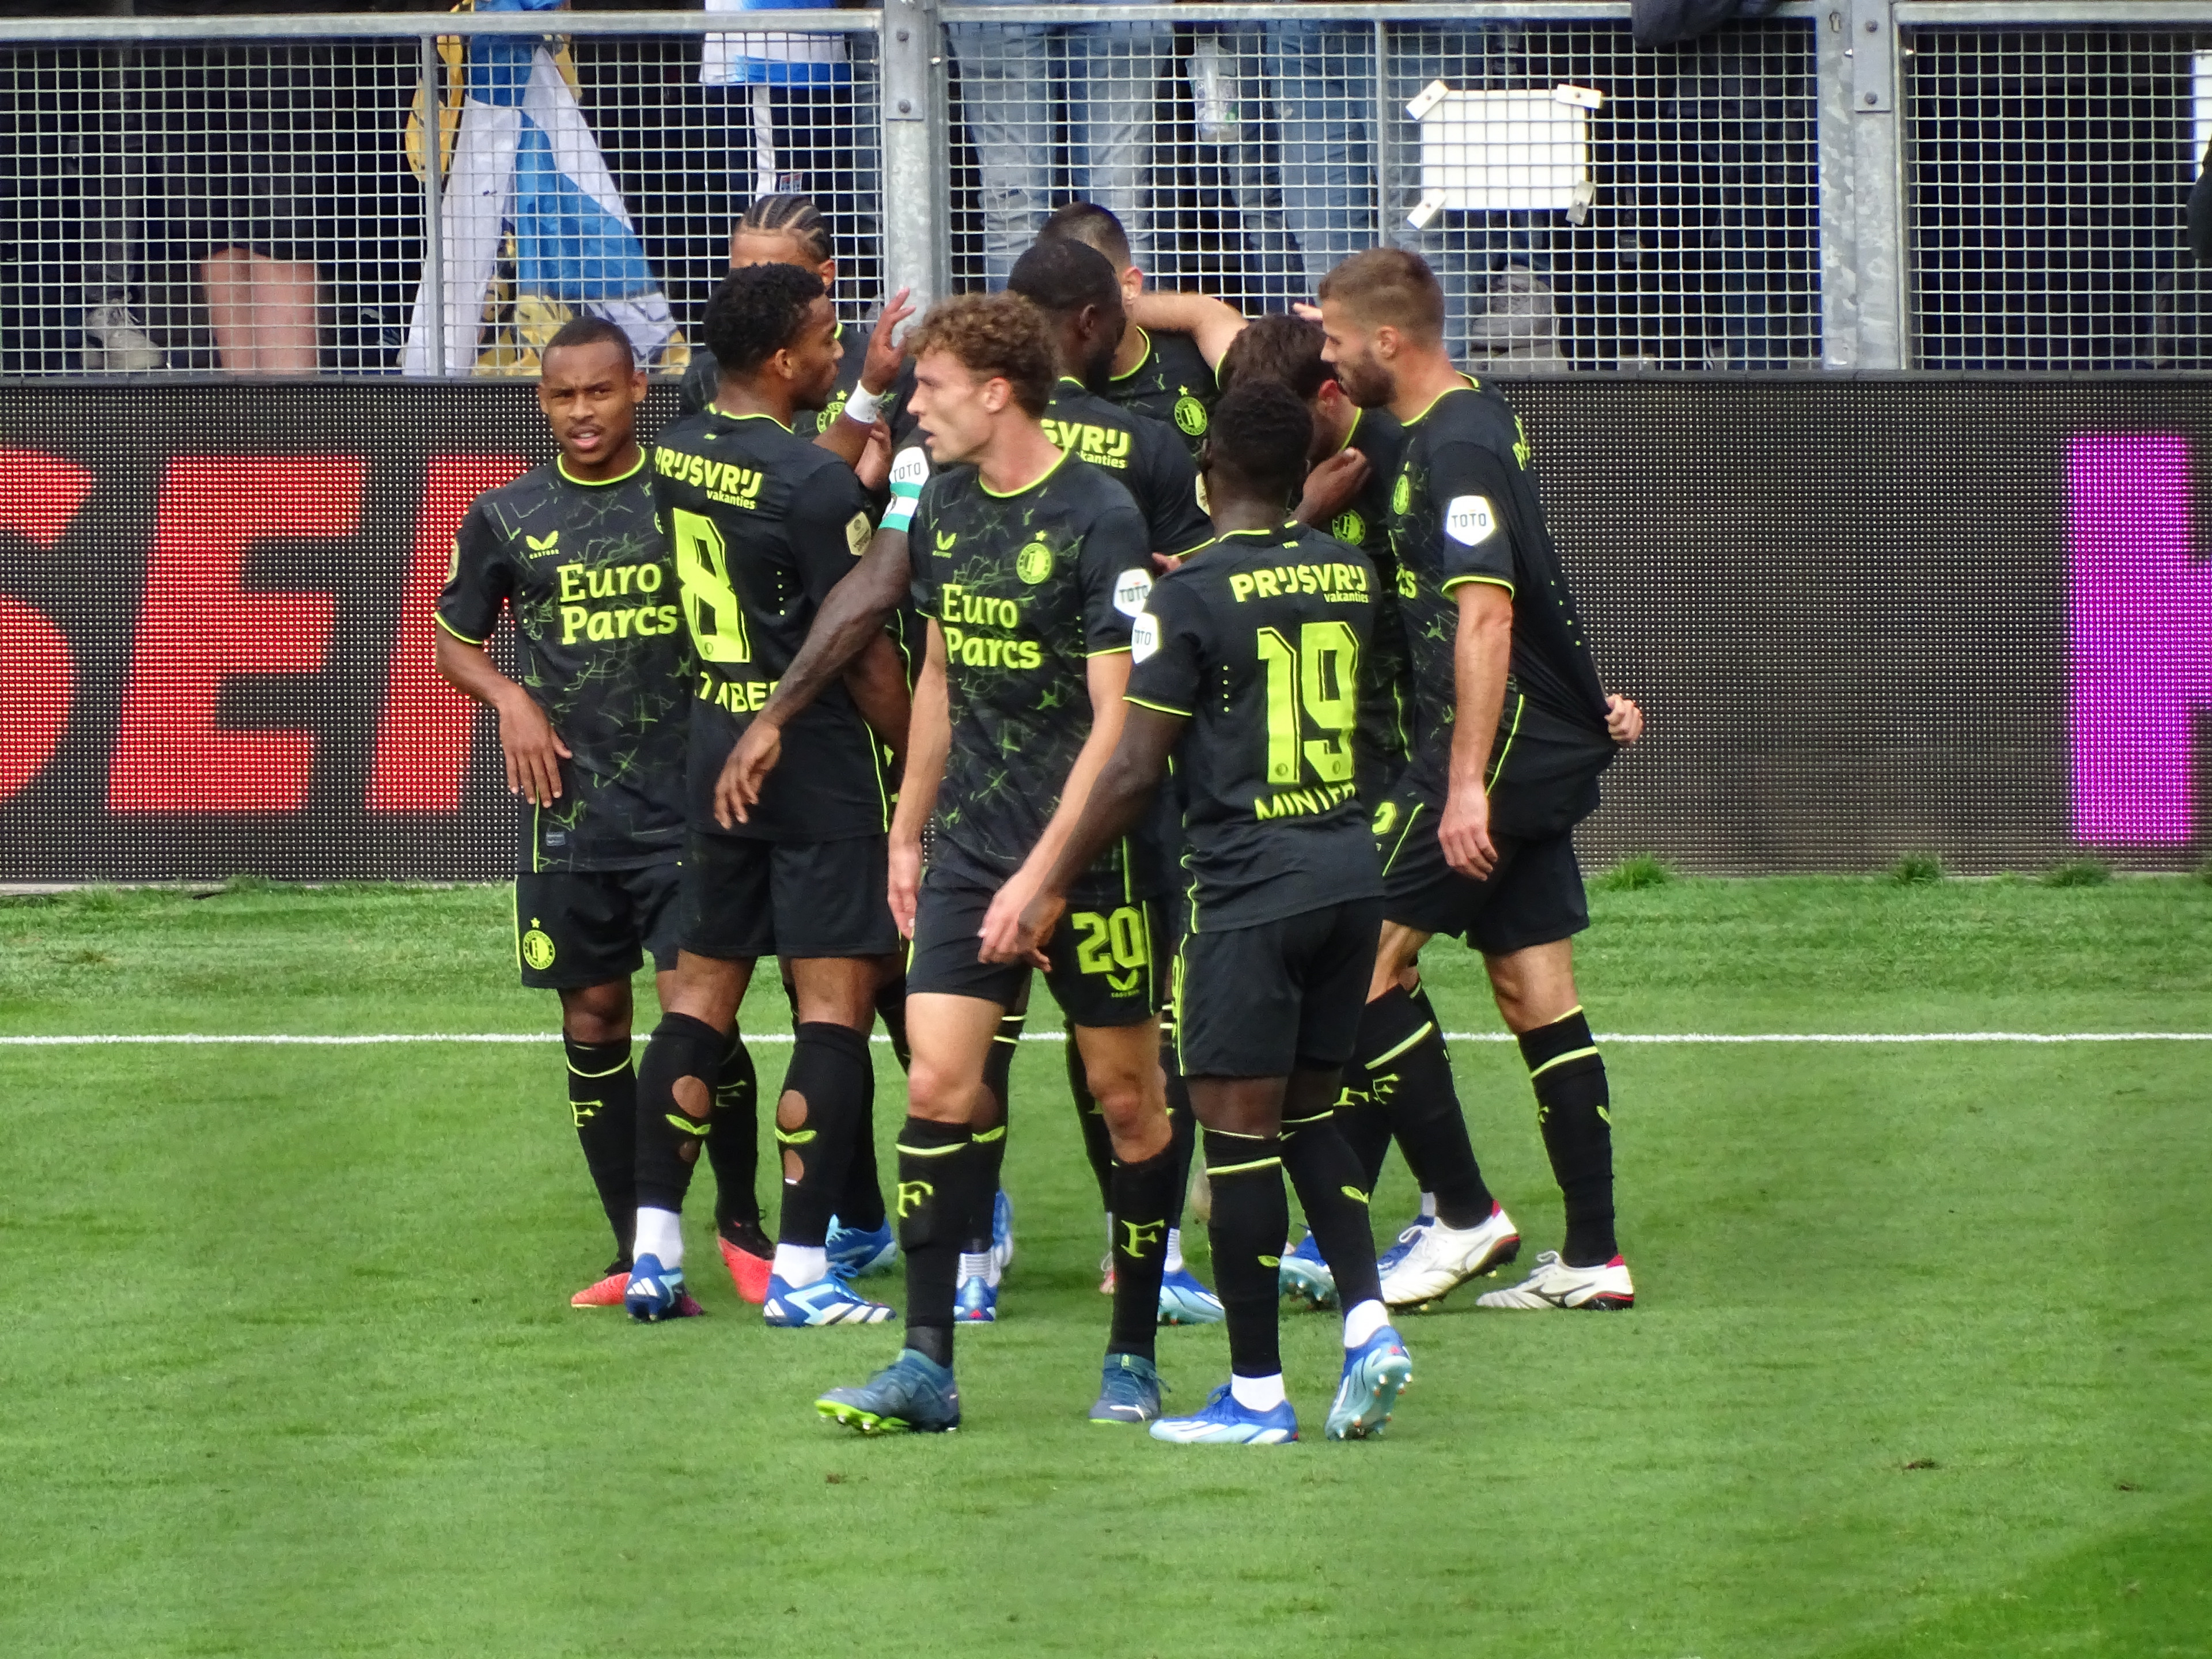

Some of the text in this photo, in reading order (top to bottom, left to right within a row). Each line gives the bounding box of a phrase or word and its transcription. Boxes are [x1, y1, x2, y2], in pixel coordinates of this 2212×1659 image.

[893, 462, 921, 483] TOTO
[1076, 450, 1129, 469] kanties
[706, 490, 757, 510] vakanties
[1451, 513, 1487, 528] TOTO
[556, 562, 661, 603] Euro
[673, 507, 750, 663] 8
[1119, 584, 1150, 604] TOTO
[1324, 590, 1369, 603] vakanties
[560, 604, 678, 645] Parcs
[941, 583, 1018, 628] Euro
[943, 627, 1042, 669] Parcs
[1257, 621, 1359, 784] 19
[1071, 906, 1147, 974] 20
[1120, 1219, 1165, 1257] F
